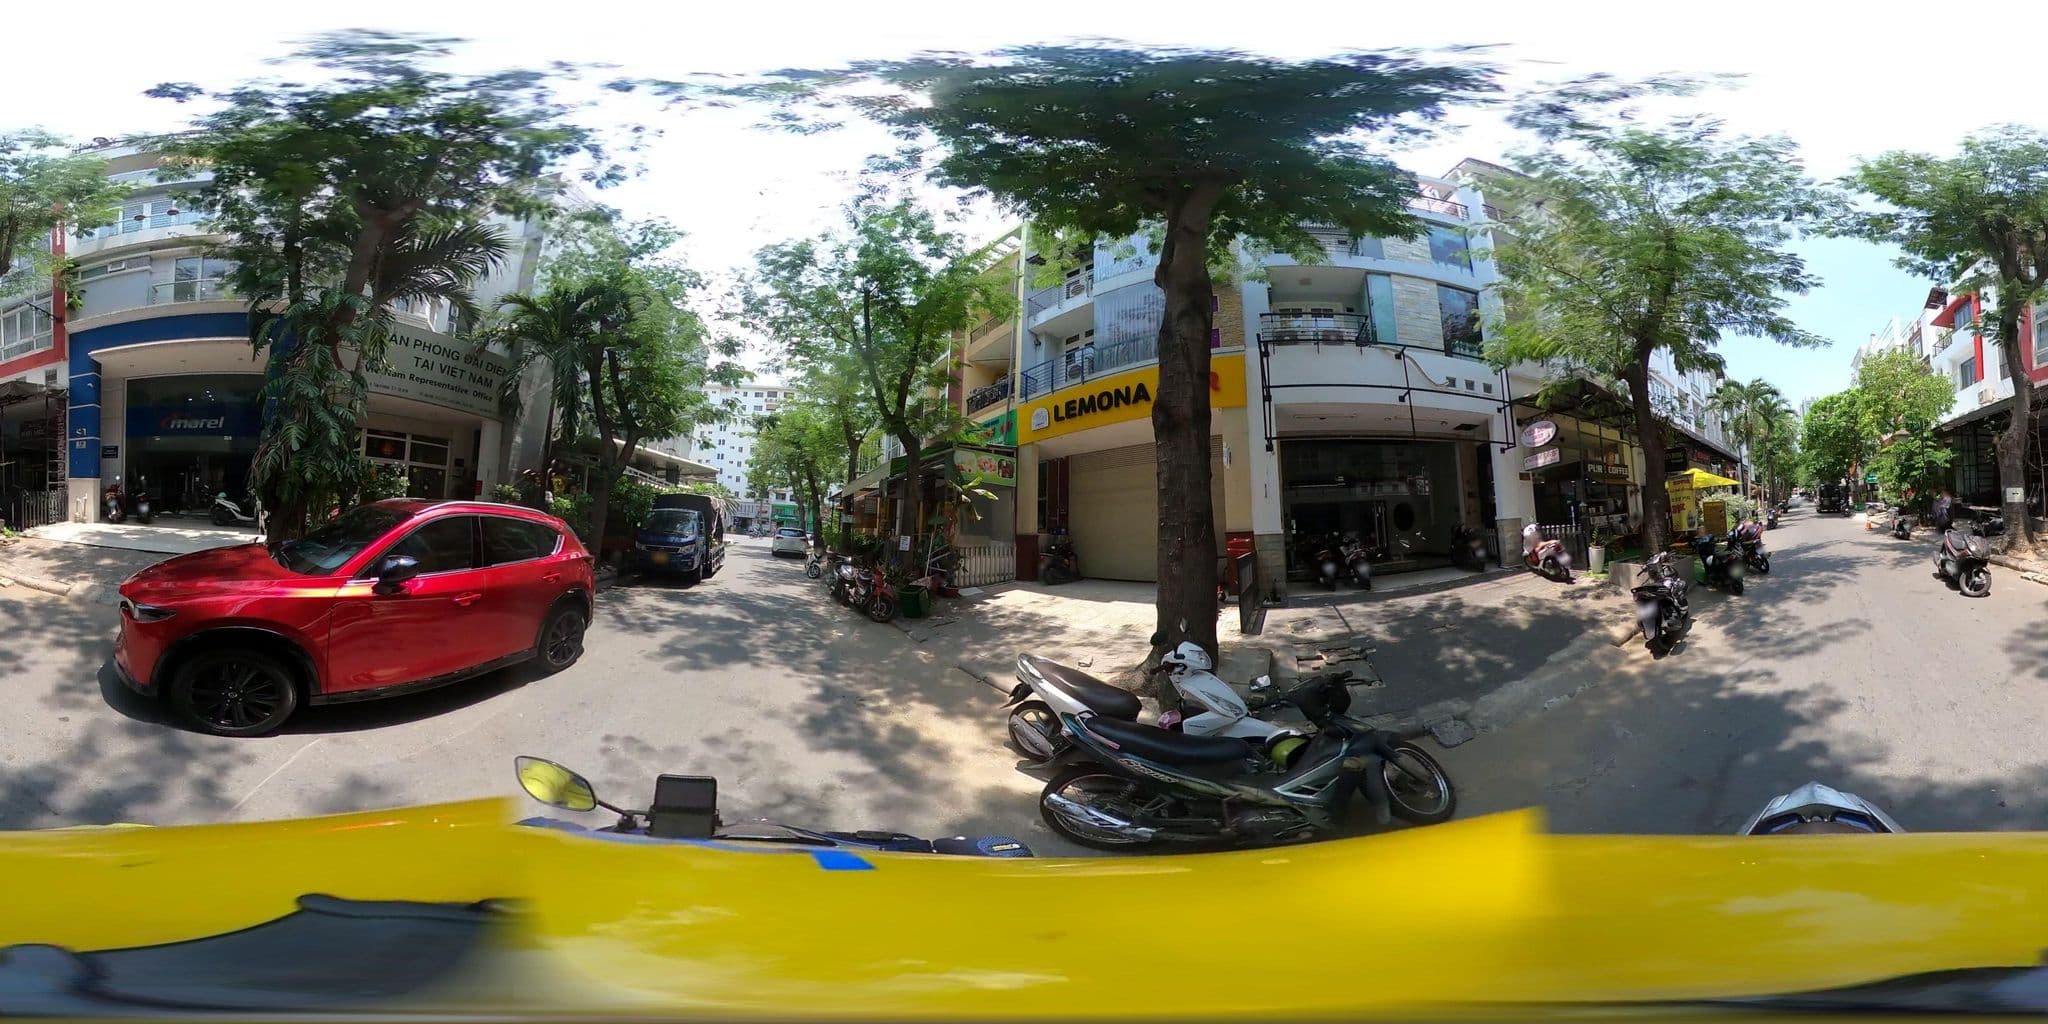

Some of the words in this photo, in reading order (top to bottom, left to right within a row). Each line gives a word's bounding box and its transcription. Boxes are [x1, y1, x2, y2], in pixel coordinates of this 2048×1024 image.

[408, 373, 469, 395] Representative
[473, 390, 493, 402] Office
[468, 372, 493, 389] NAM
[1053, 382, 1153, 422] LEMONA
[170, 415, 225, 429] marel
